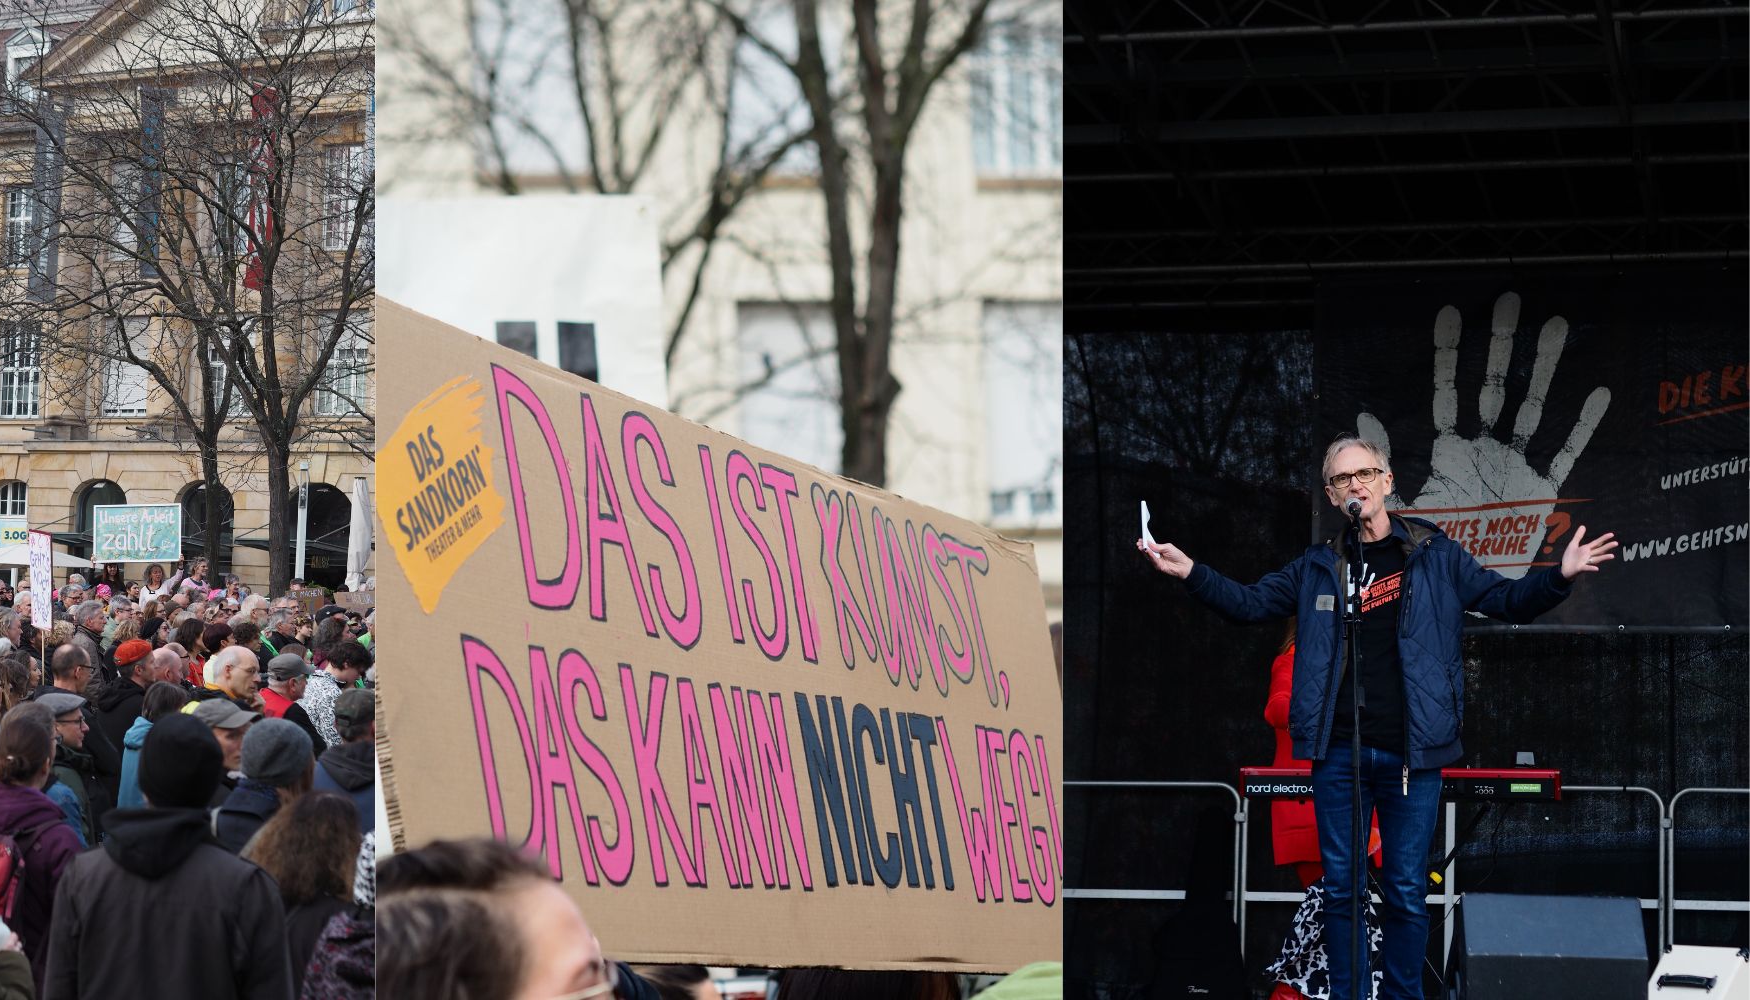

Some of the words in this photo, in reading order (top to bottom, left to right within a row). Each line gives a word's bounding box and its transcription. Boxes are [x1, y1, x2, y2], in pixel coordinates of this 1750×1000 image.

[1658, 370, 1712, 414] DIE
[406, 425, 444, 483] DAS
[1661, 456, 1749, 490] UNTERSTÜT
[99, 510, 139, 527] Unsere
[141, 508, 175, 524] Arbeit
[490, 362, 703, 650] DAS
[698, 444, 818, 663] IST
[1486, 514, 1540, 536] NOCH
[102, 524, 156, 551] zählt
[425, 526, 457, 563] THEATER
[461, 504, 483, 534] MEHR
[460, 633, 635, 887] DAS
[618, 663, 813, 891] KANN
[795, 692, 955, 890] NICHT
[1247, 784, 1271, 793] nord
